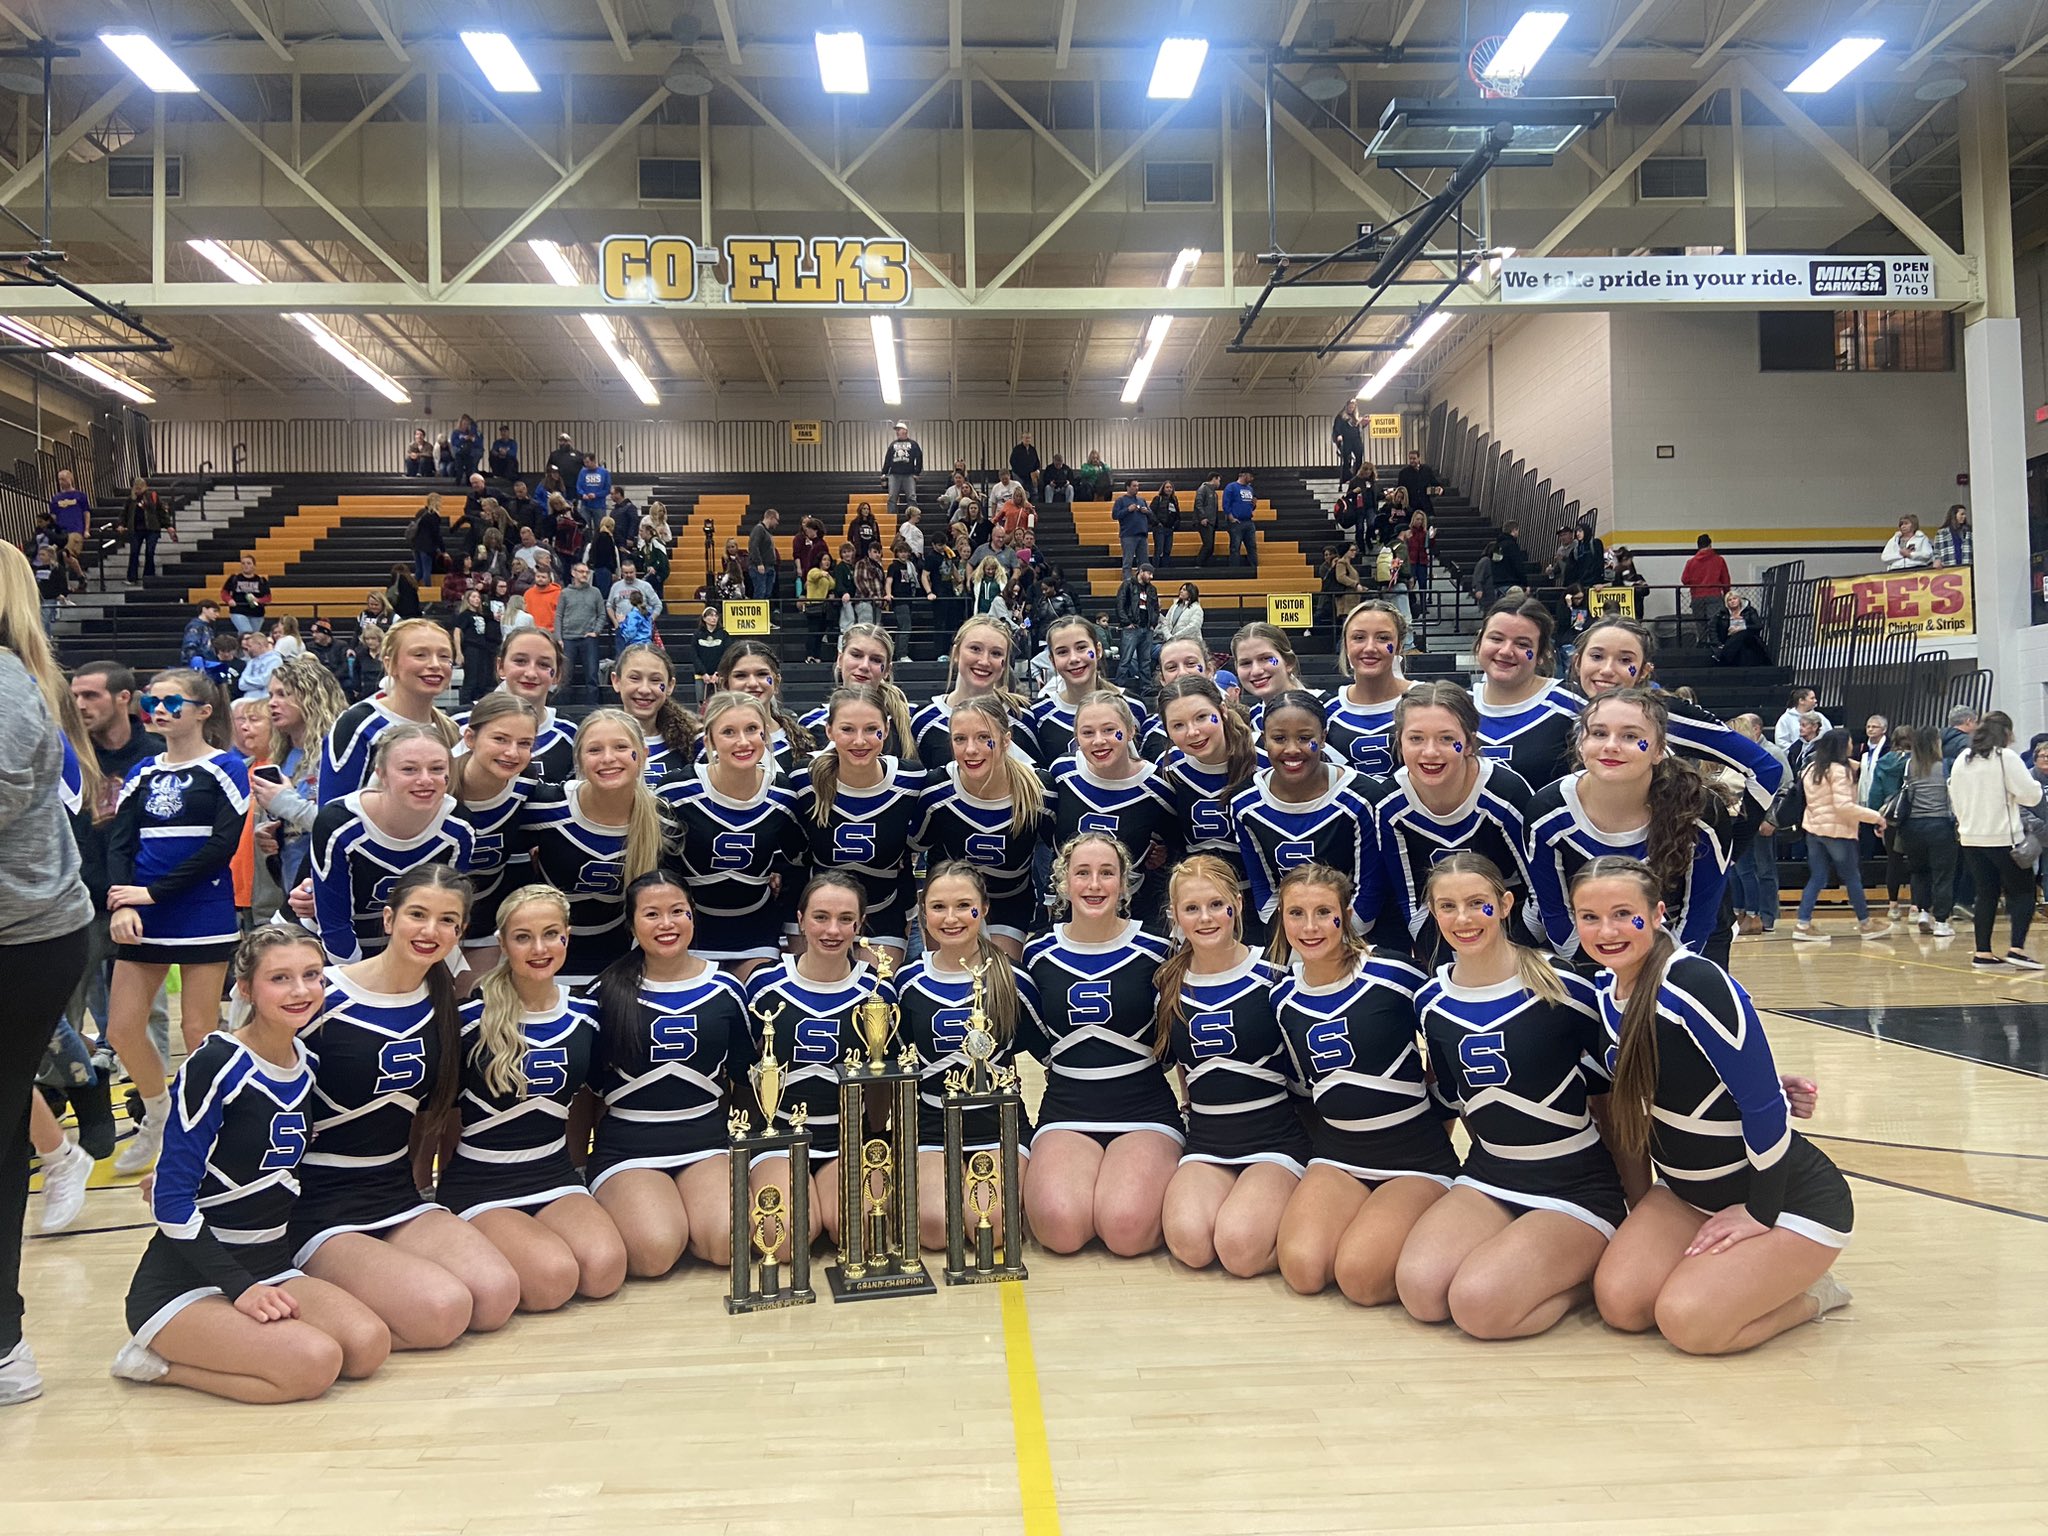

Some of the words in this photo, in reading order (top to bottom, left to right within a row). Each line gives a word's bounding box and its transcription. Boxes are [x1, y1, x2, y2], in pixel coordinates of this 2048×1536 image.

[603, 237, 696, 302] GO
[727, 238, 909, 303] ELKS
[1504, 271, 1538, 288] We
[1543, 271, 1594, 288] take
[1599, 270, 1661, 291] pride
[1666, 270, 1688, 287] in
[1694, 271, 1746, 290] your
[1751, 269, 1802, 286] ride.
[1816, 262, 1880, 281] MIKE'S
[1893, 262, 1928, 271] OPEN
[1894, 274, 1929, 283] DAILY
[1895, 285, 1902, 295] 7
[1905, 285, 1918, 295] to
[1921, 285, 1928, 295] 9
[731, 606, 761, 616] VISITOR
[1275, 599, 1305, 609] VISITOR
[1593, 606, 1631, 616] STTS
[1596, 593, 1626, 603] VISITOR
[737, 619, 756, 629] FANS
[1281, 612, 1299, 622] FANS
[1888, 621, 1923, 635] Chicken
[1926, 619, 1935, 631] &
[1936, 618, 1965, 632] Strips
[1350, 734, 1394, 776] S
[1191, 799, 1231, 839] S
[711, 832, 755, 870] S
[833, 823, 876, 863] S
[964, 833, 1006, 866] S
[575, 860, 626, 893] S
[1067, 980, 1113, 1026] S
[650, 1014, 698, 1063] S
[793, 1017, 841, 1064] S
[1188, 1009, 1238, 1059] S
[1305, 1016, 1357, 1073] S
[373, 1037, 426, 1094] S
[844, 1047, 860, 1062] 20
[1457, 1030, 1512, 1087] S
[516, 1047, 569, 1098] S
[943, 1069, 959, 1084] 20
[1001, 1065, 1015, 1079] 23
[733, 1109, 749, 1123] 20
[791, 1102, 807, 1117] 23
[259, 1111, 307, 1170] S
[856, 1281, 883, 1291] GRAND
[884, 1277, 924, 1288] CHAMPION
